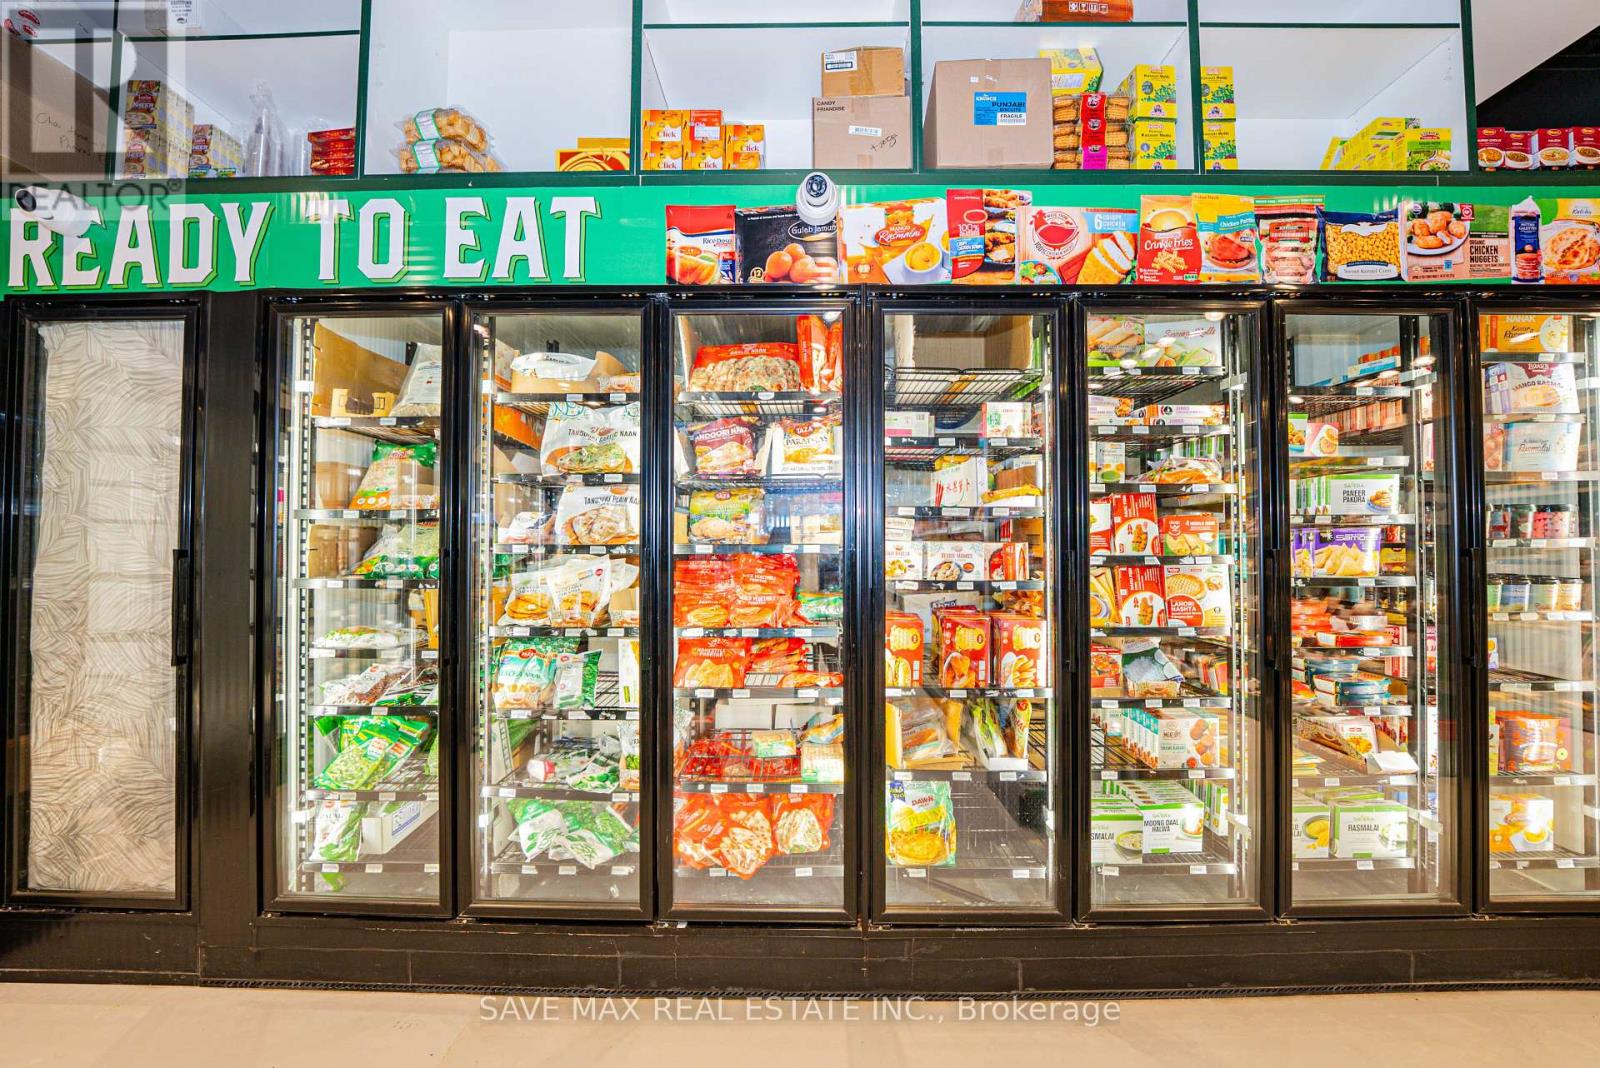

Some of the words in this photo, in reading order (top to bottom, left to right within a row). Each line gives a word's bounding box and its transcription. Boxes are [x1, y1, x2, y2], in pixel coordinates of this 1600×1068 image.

[656, 130, 677, 139] Click
[740, 143, 760, 153] Click
[657, 161, 677, 170] Click
[698, 161, 718, 169] Click
[1094, 214, 1103, 230] 6
[1219, 220, 1240, 228] Chicken
[791, 225, 813, 235] Gulab
[958, 223, 980, 233] 100%
[878, 229, 922, 243] Rasmalai
[8, 202, 274, 291] READY
[306, 198, 410, 285] TO
[442, 196, 602, 283] EAT
[702, 237, 716, 245] Rice
[1144, 240, 1174, 251] Crinkle
[1173, 238, 1193, 248] Fries
[1469, 245, 1499, 255] CHICKEN
[1469, 255, 1499, 264] NUGGETS
[753, 268, 762, 278] 12
[619, 430, 638, 438] NAAN
[796, 427, 814, 435] TAZA
[1342, 489, 1366, 497] PANEER
[1342, 496, 1366, 504] PAKORA
[911, 795, 934, 806] DAWN
[1347, 823, 1380, 832] RASMALAI
